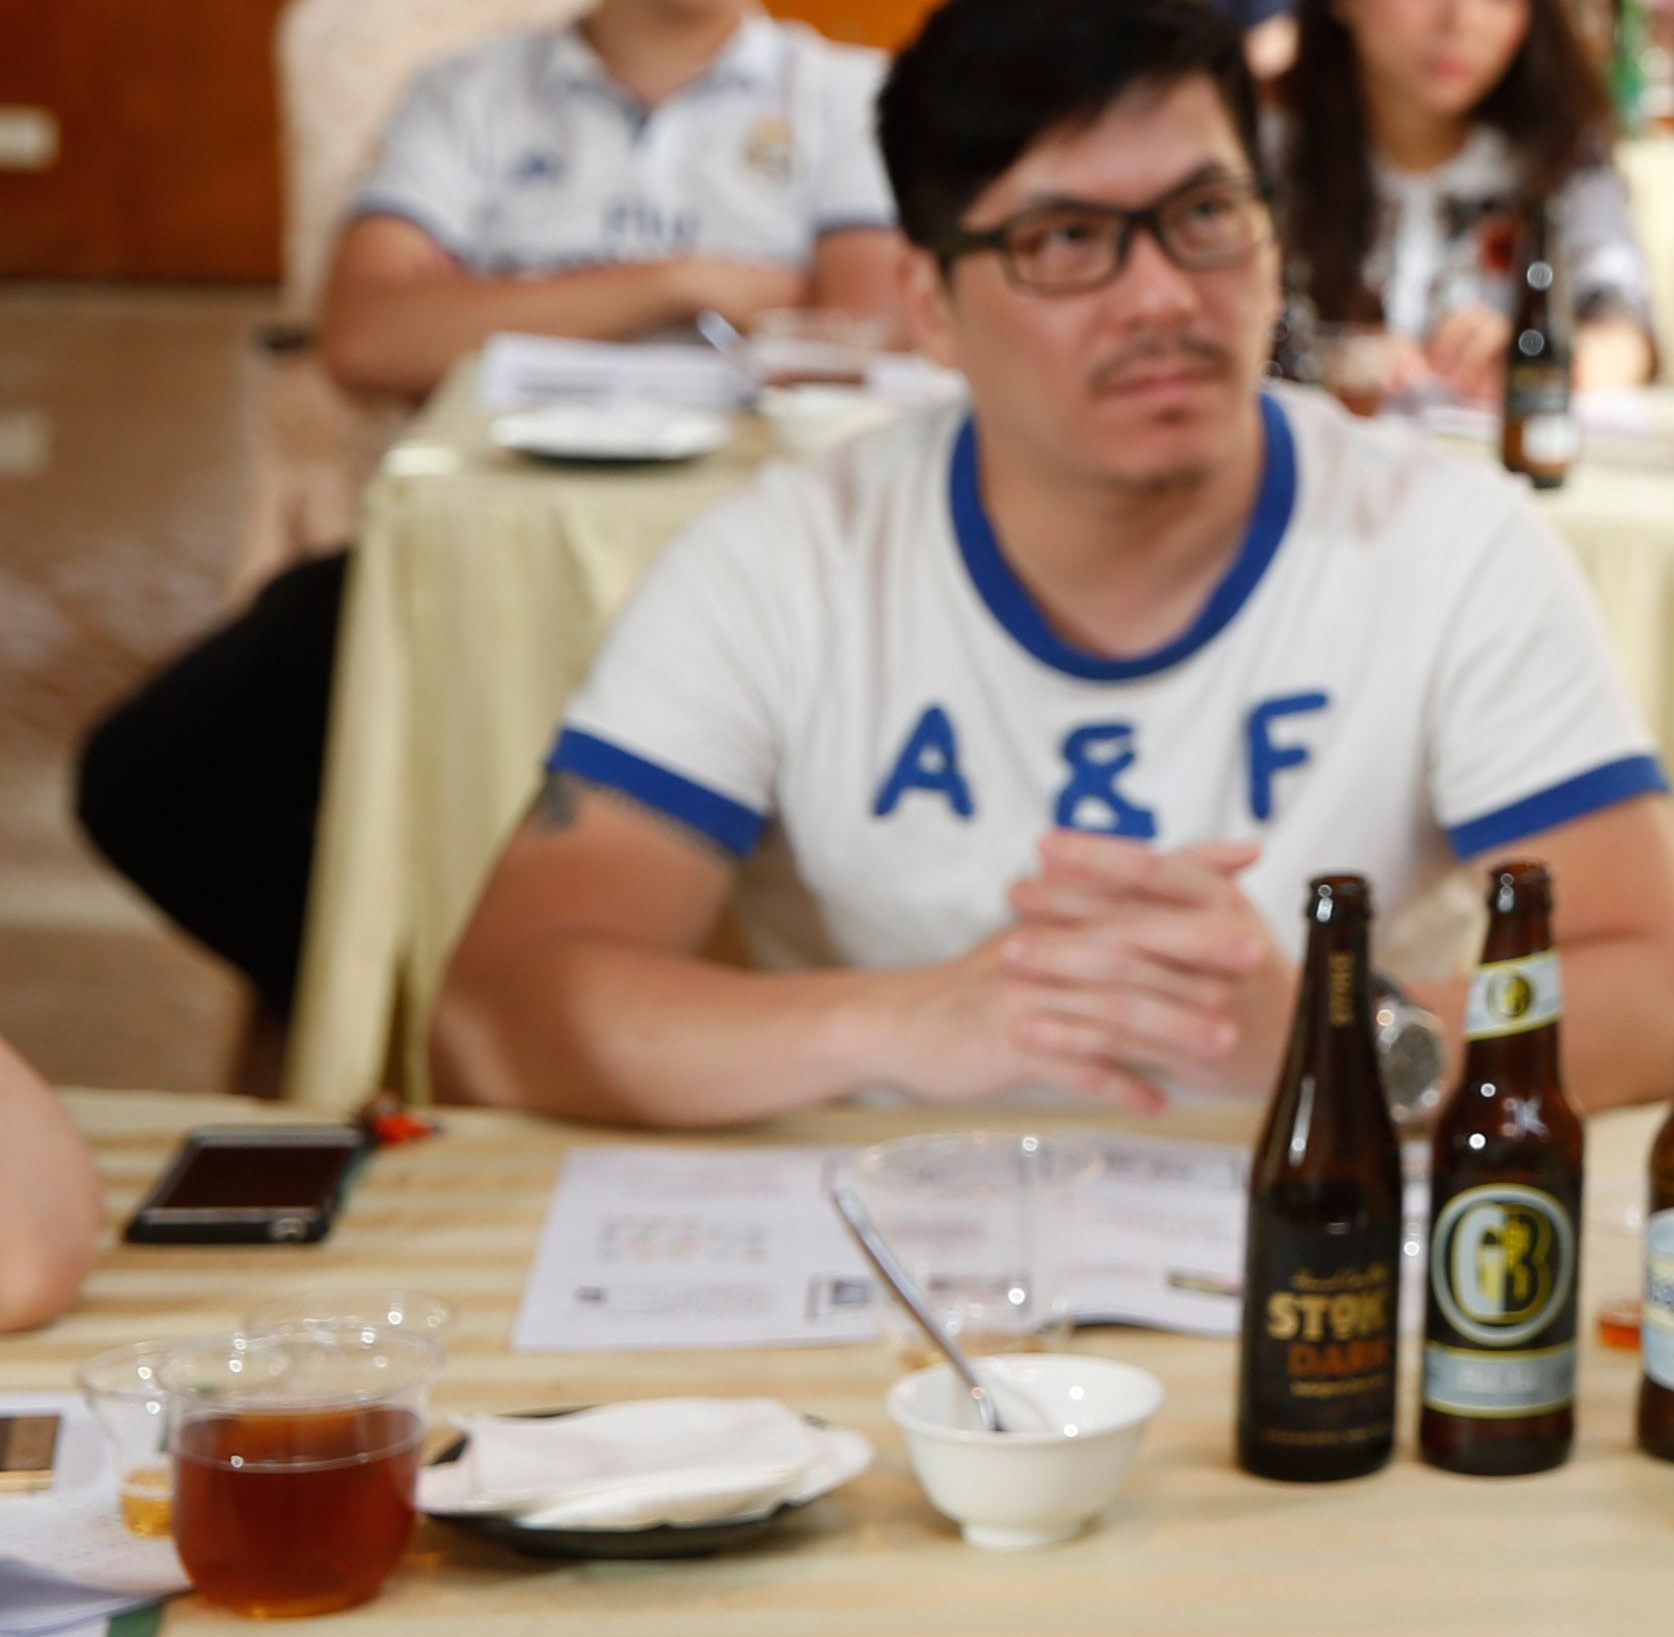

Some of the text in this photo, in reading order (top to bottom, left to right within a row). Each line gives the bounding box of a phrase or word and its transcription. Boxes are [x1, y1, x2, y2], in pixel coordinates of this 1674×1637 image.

[875, 691, 1330, 839] A & F
